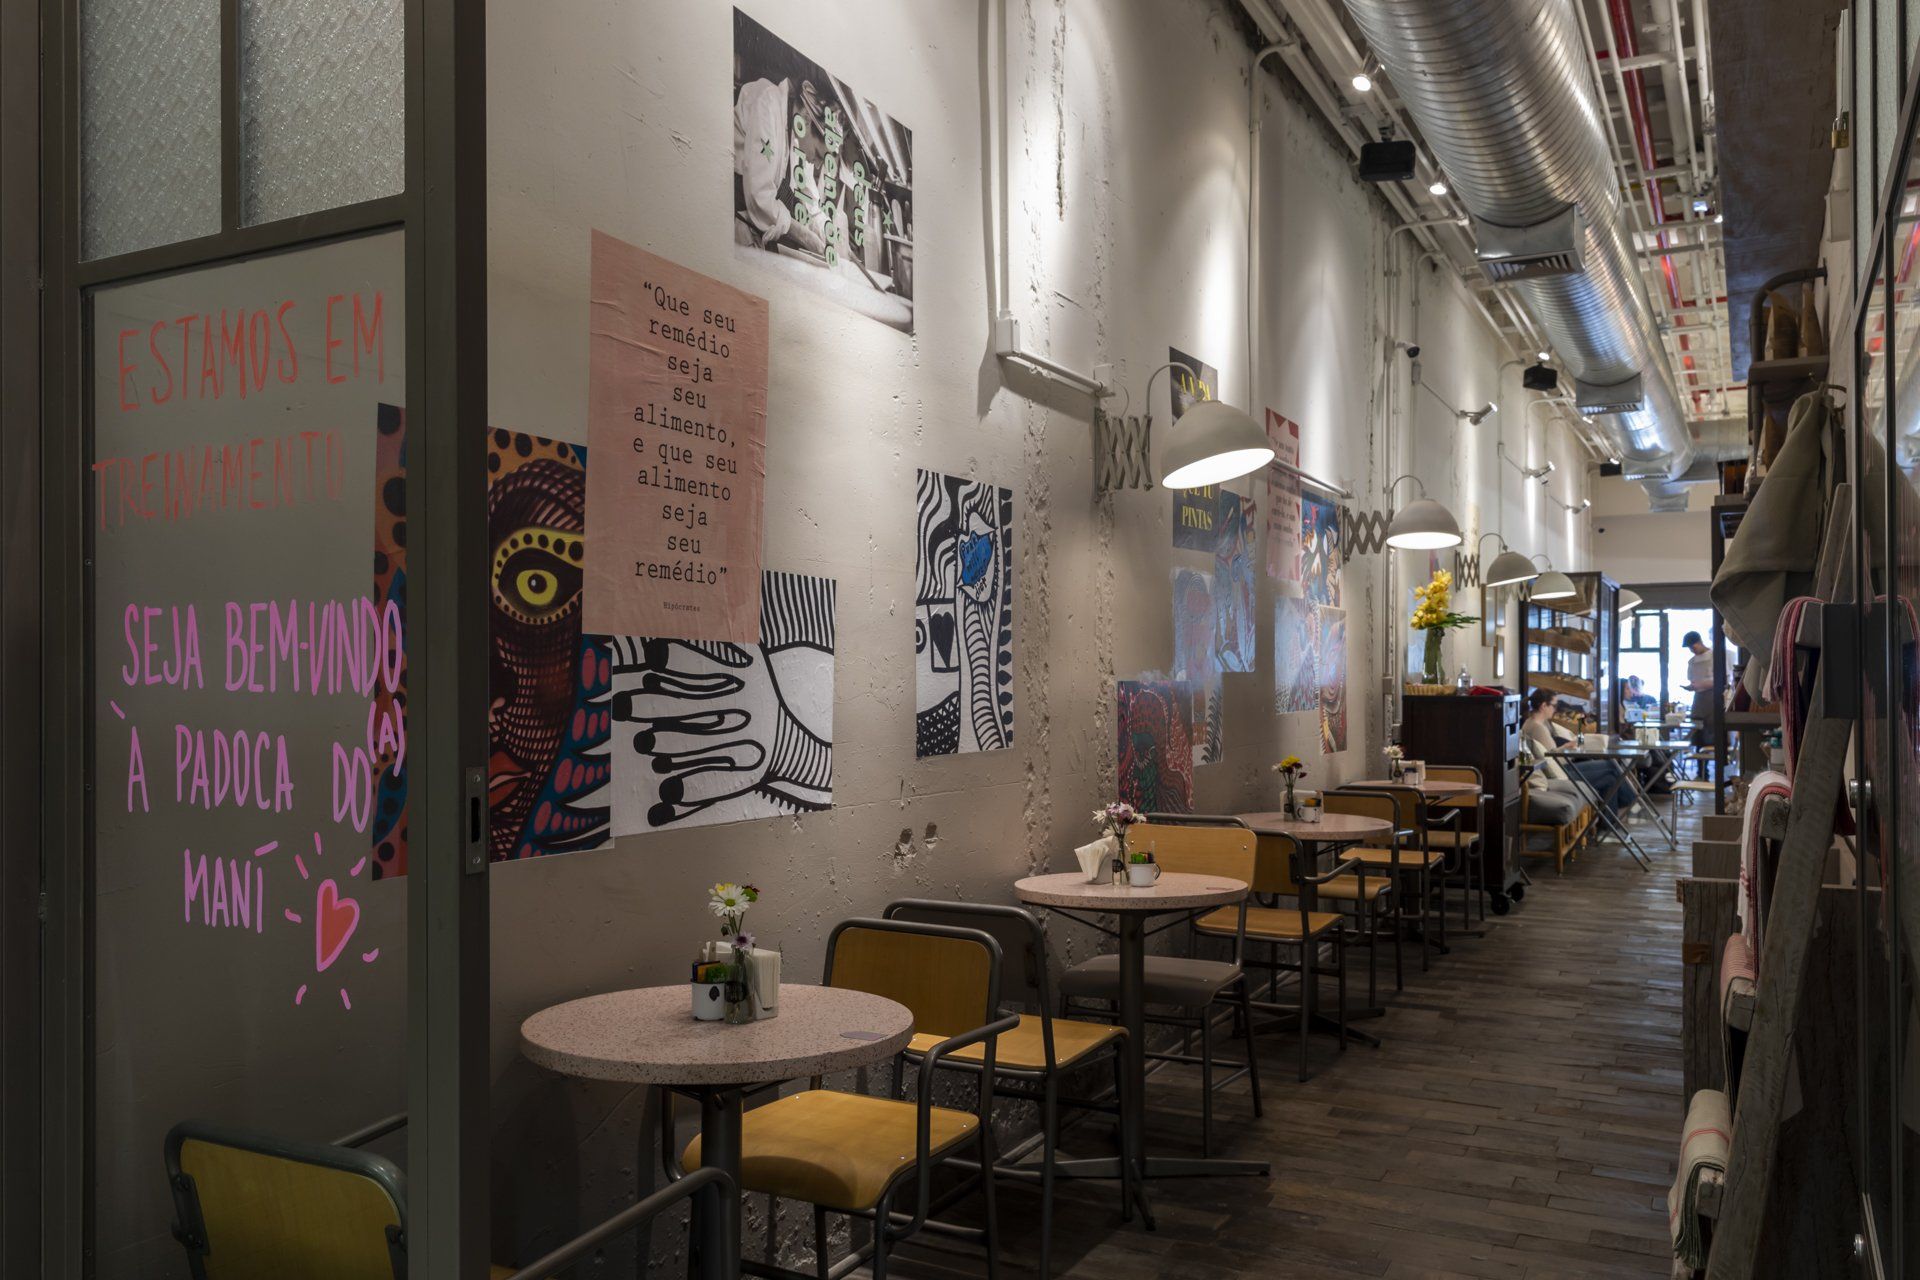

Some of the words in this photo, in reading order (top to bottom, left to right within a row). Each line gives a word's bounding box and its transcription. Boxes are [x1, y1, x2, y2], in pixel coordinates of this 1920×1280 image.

[793, 113, 807, 138] o
[853, 161, 873, 248] deus
[649, 318, 730, 359] remédio
[703, 308, 736, 333] seu
[118, 300, 298, 412] ESTAMOS
[325, 290, 384, 385] EM
[667, 355, 713, 383] seja
[673, 386, 707, 409] seu
[633, 403, 736, 448] alimento,
[633, 437, 644, 453] e
[658, 442, 693, 464] que
[705, 454, 738, 475] seu
[91, 428, 345, 531] TREINAMENTO
[637, 465, 732, 501] alimento
[661, 503, 708, 530] seja
[1182, 505, 1213, 532] PINTAS
[667, 535, 702, 554] seu
[635, 560, 728, 585] remédio”
[122, 603, 204, 691] SEJA
[225, 596, 403, 697] BEM-VINDO
[175, 724, 294, 813] PADOCA
[184, 840, 278, 933] MANÍ
